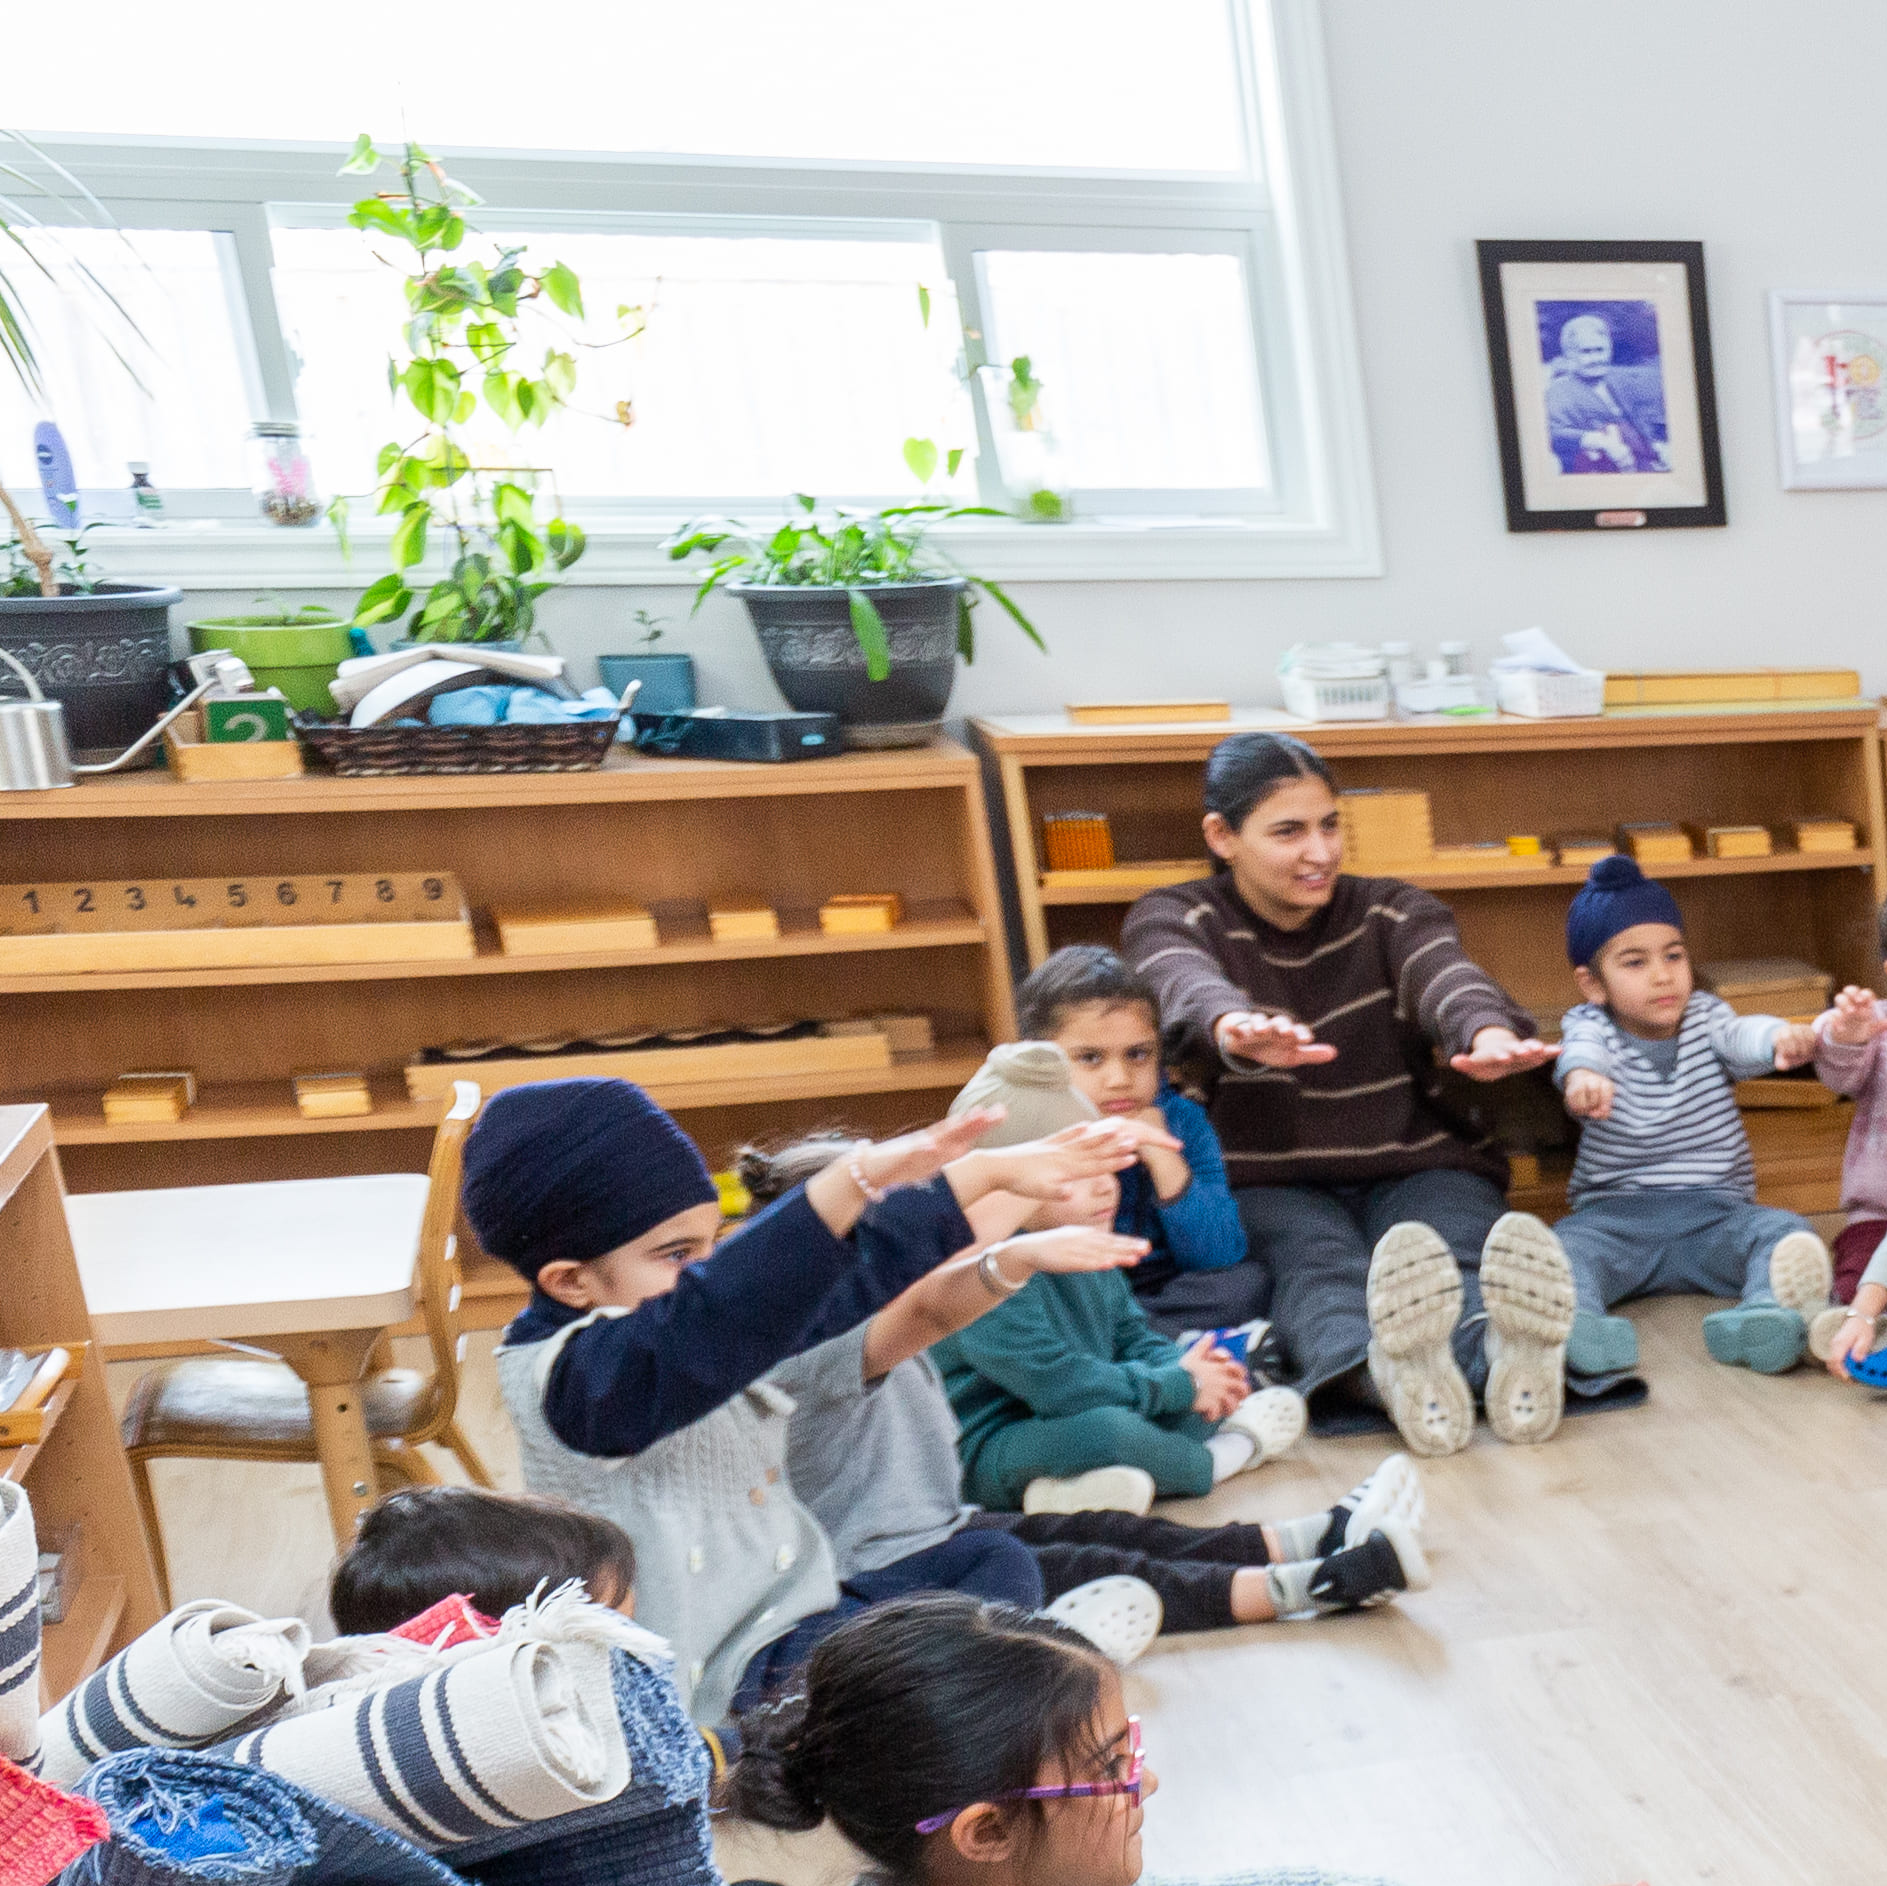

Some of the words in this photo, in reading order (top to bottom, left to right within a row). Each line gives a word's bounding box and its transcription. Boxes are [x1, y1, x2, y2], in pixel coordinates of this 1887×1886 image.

[22, 889, 40, 914] 1
[73, 888, 97, 913] 2
[125, 886, 148, 911] 3
[173, 885, 197, 909] 4
[227, 883, 248, 908] 5
[276, 881, 299, 906] 6
[325, 879, 345, 904] 7
[375, 878, 396, 902] 8
[422, 876, 445, 901] 9
